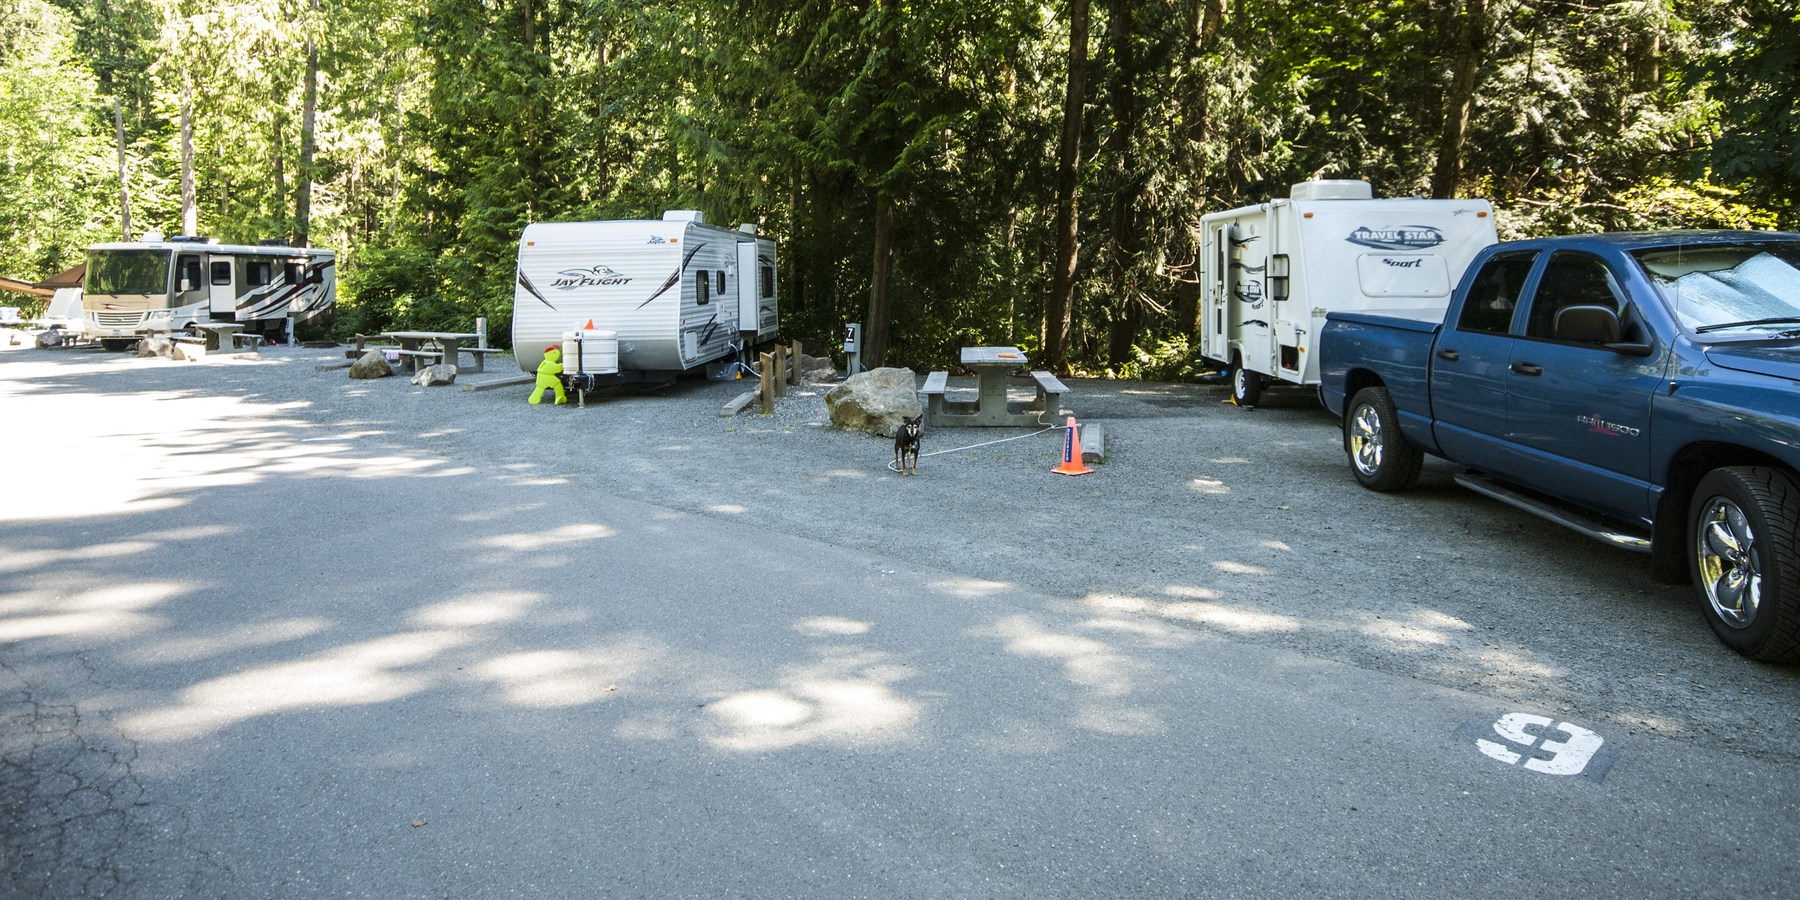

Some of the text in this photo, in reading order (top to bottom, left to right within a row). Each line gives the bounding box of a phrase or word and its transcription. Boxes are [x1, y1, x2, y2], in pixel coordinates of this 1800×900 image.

[1354, 230, 1436, 240] TRAVEL STAR
[550, 278, 633, 287] JAY FLIGHT
[847, 327, 854, 338] 7
[1606, 421, 1640, 437] 1500
